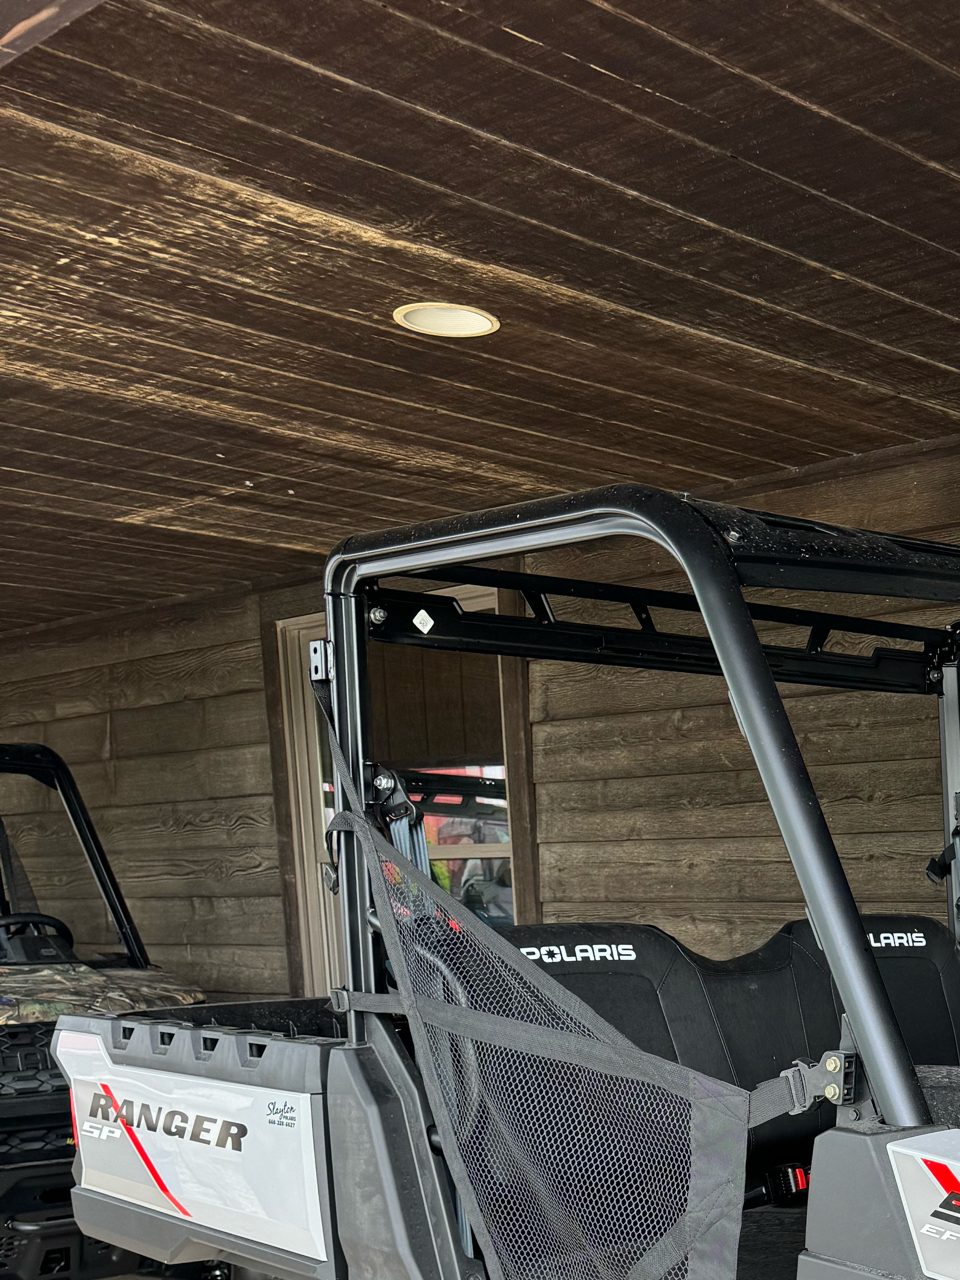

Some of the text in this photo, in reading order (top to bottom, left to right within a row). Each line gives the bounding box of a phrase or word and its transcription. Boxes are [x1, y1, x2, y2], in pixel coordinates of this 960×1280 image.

[868, 932, 926, 947] LARIS
[519, 944, 637, 963] POLARIS
[266, 1101, 296, 1120] Slayton
[80, 1120, 123, 1141] SP
[89, 1092, 249, 1152] RANGER
